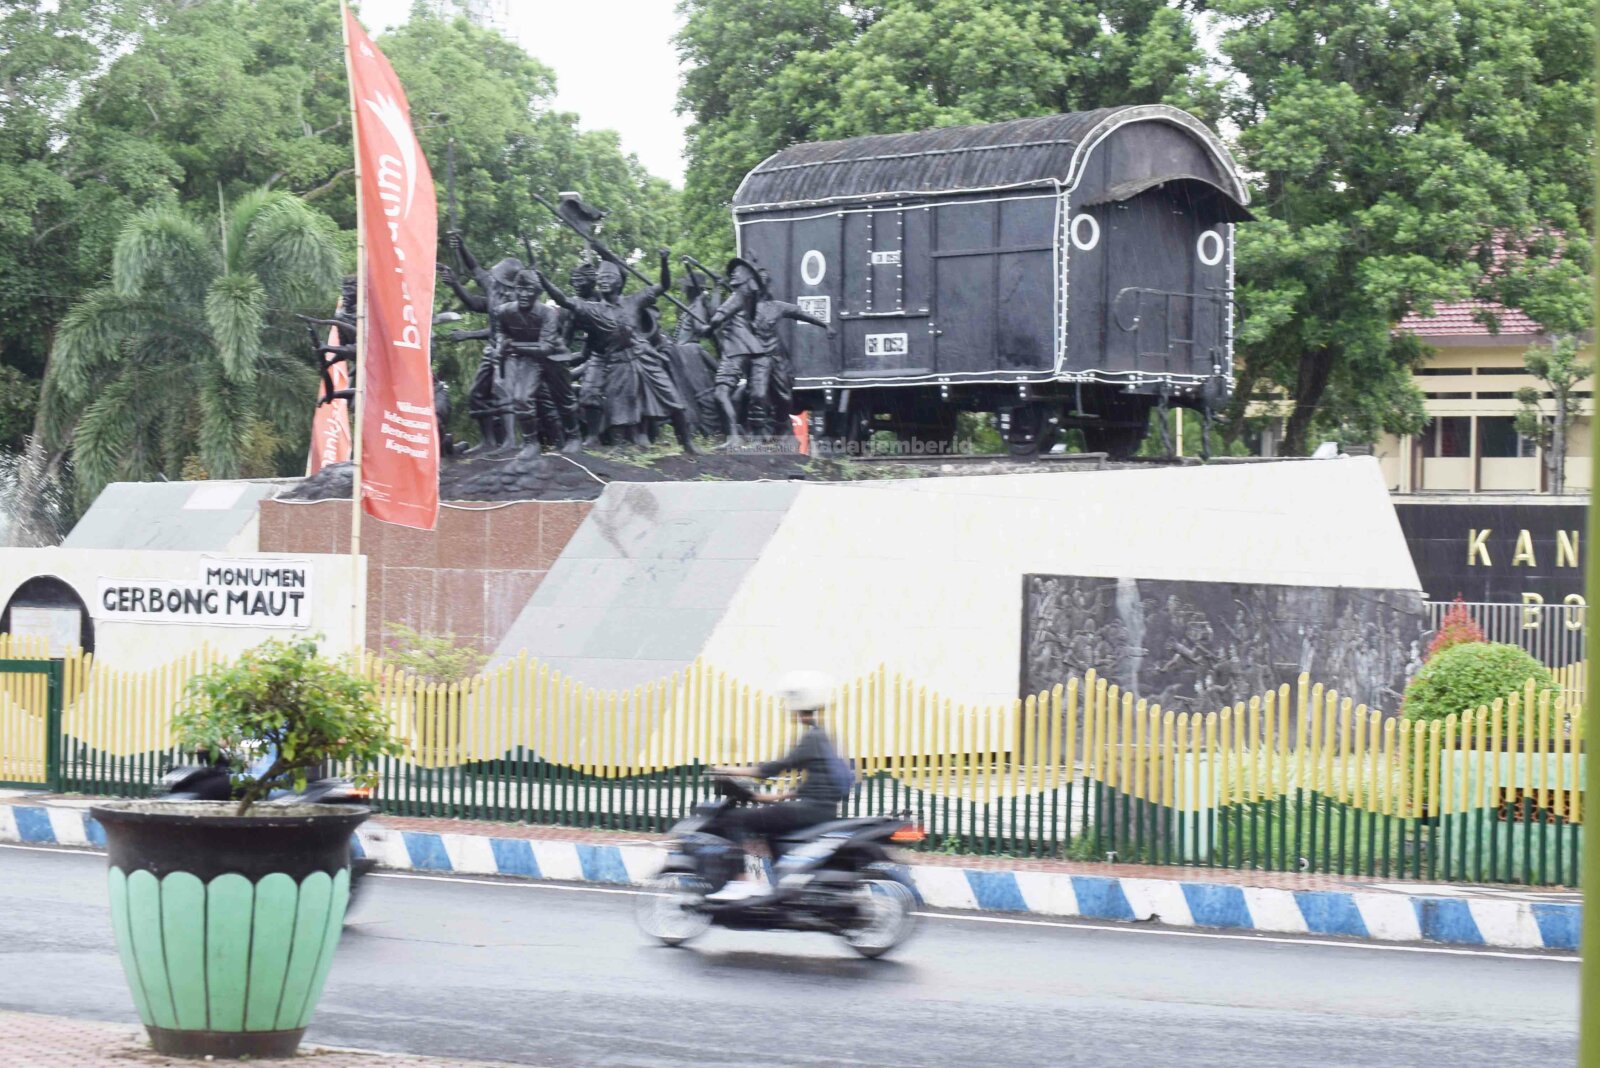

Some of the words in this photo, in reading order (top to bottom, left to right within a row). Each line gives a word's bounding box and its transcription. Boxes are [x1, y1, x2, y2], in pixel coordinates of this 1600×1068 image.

[1467, 528, 1580, 568] KAN
[206, 568, 305, 587] MONUMEN
[103, 587, 219, 614] GERBONG
[225, 589, 305, 617] MAUT
